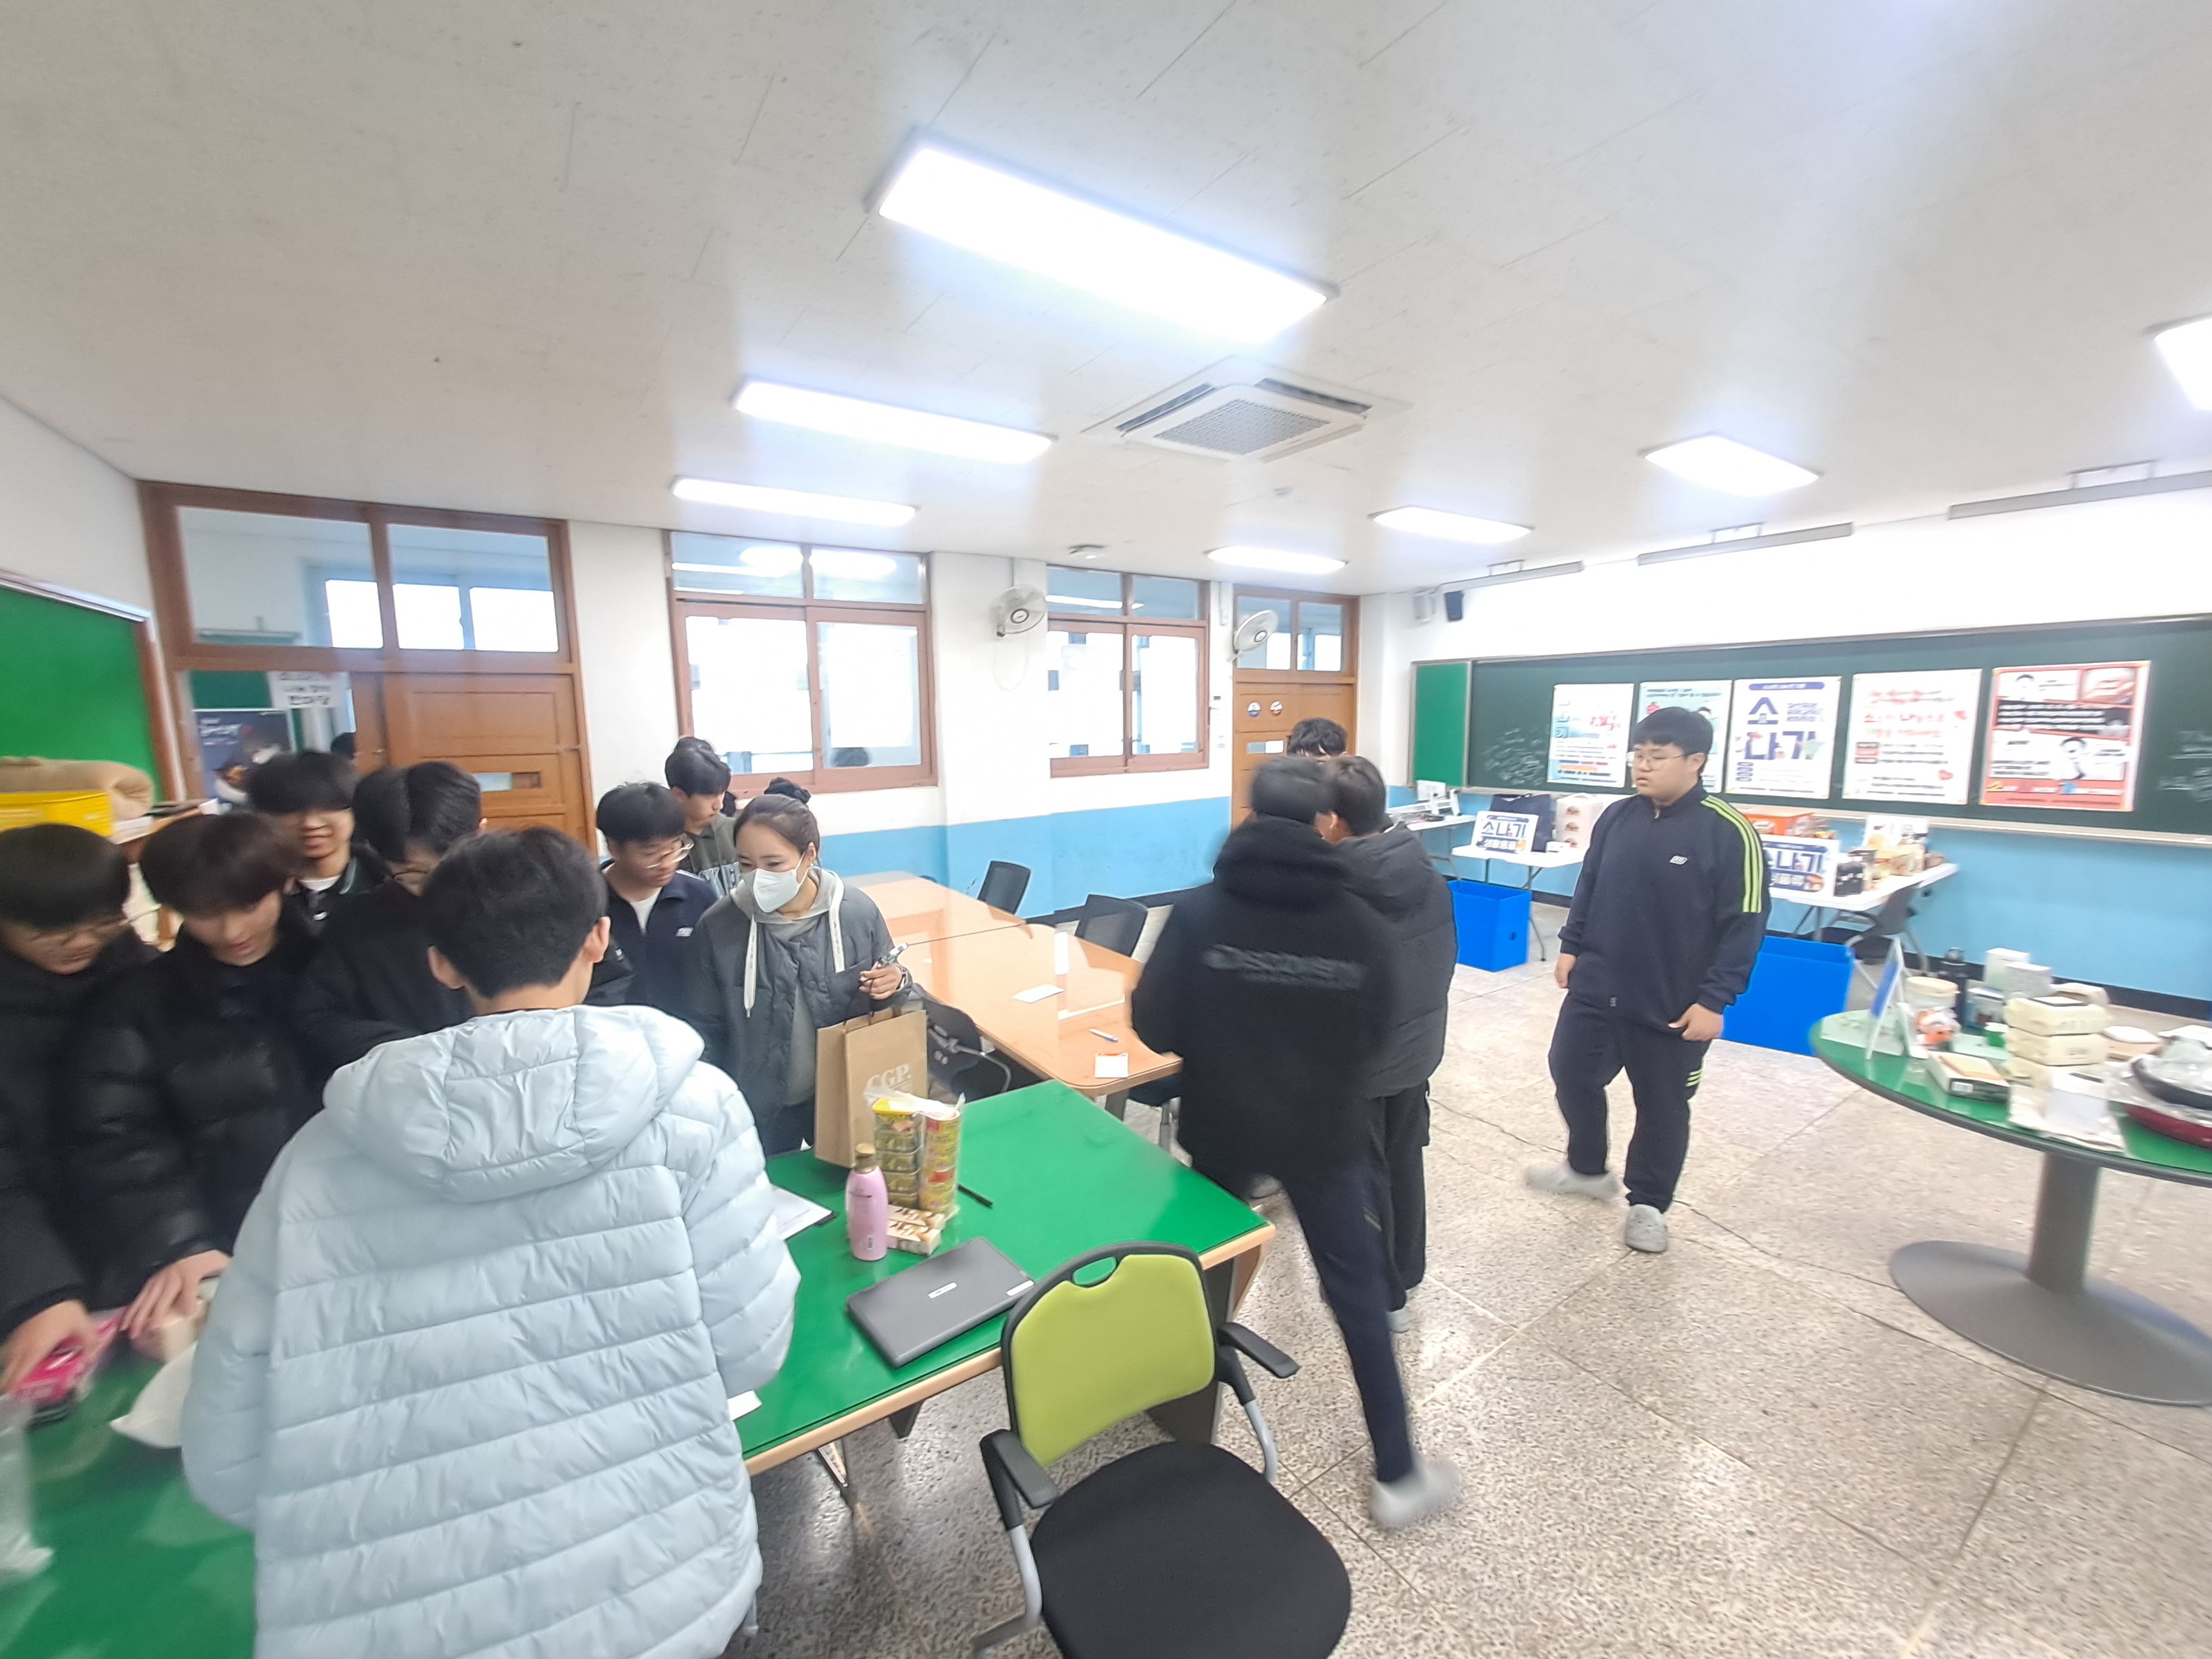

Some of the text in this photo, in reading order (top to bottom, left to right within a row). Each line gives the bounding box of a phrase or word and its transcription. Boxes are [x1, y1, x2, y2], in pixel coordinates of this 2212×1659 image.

[1747, 697, 1779, 724] 소
[1481, 821, 1526, 838] 소나기
[1766, 851, 1823, 873] 나기
